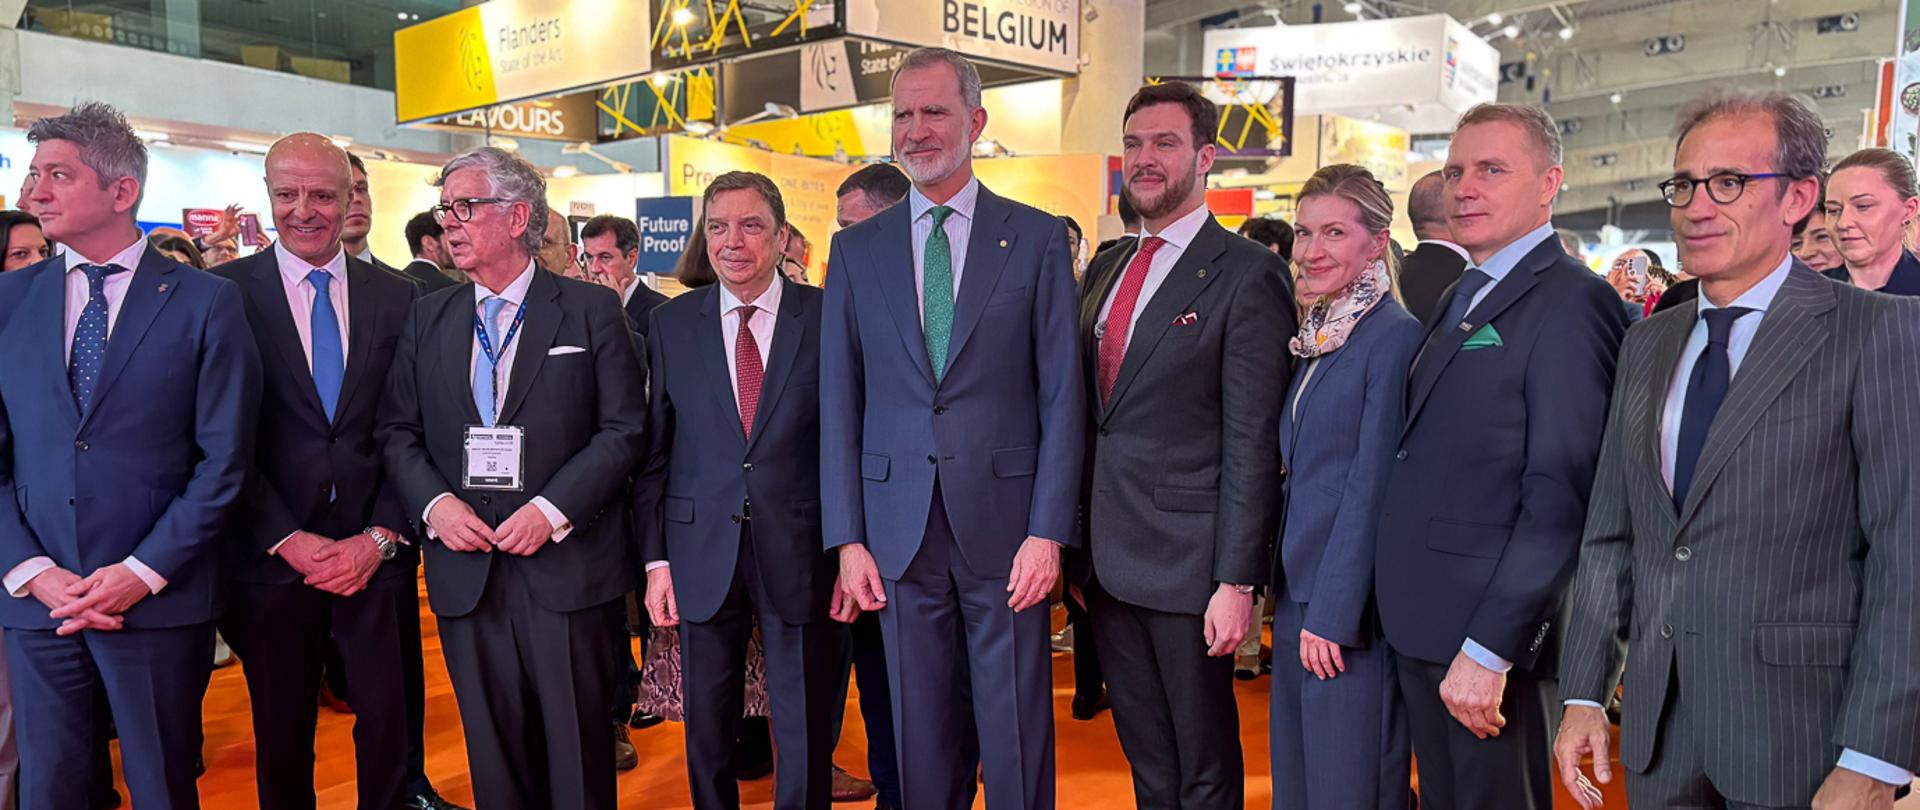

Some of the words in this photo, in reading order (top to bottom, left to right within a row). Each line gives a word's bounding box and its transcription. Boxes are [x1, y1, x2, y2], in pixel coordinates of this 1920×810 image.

[499, 15, 561, 52] Flanders
[943, 0, 1067, 55] BELGIUM
[860, 58, 888, 75] State
[442, 103, 565, 135] LAVOURS
[640, 216, 688, 233] Future
[644, 235, 685, 252] Proof
